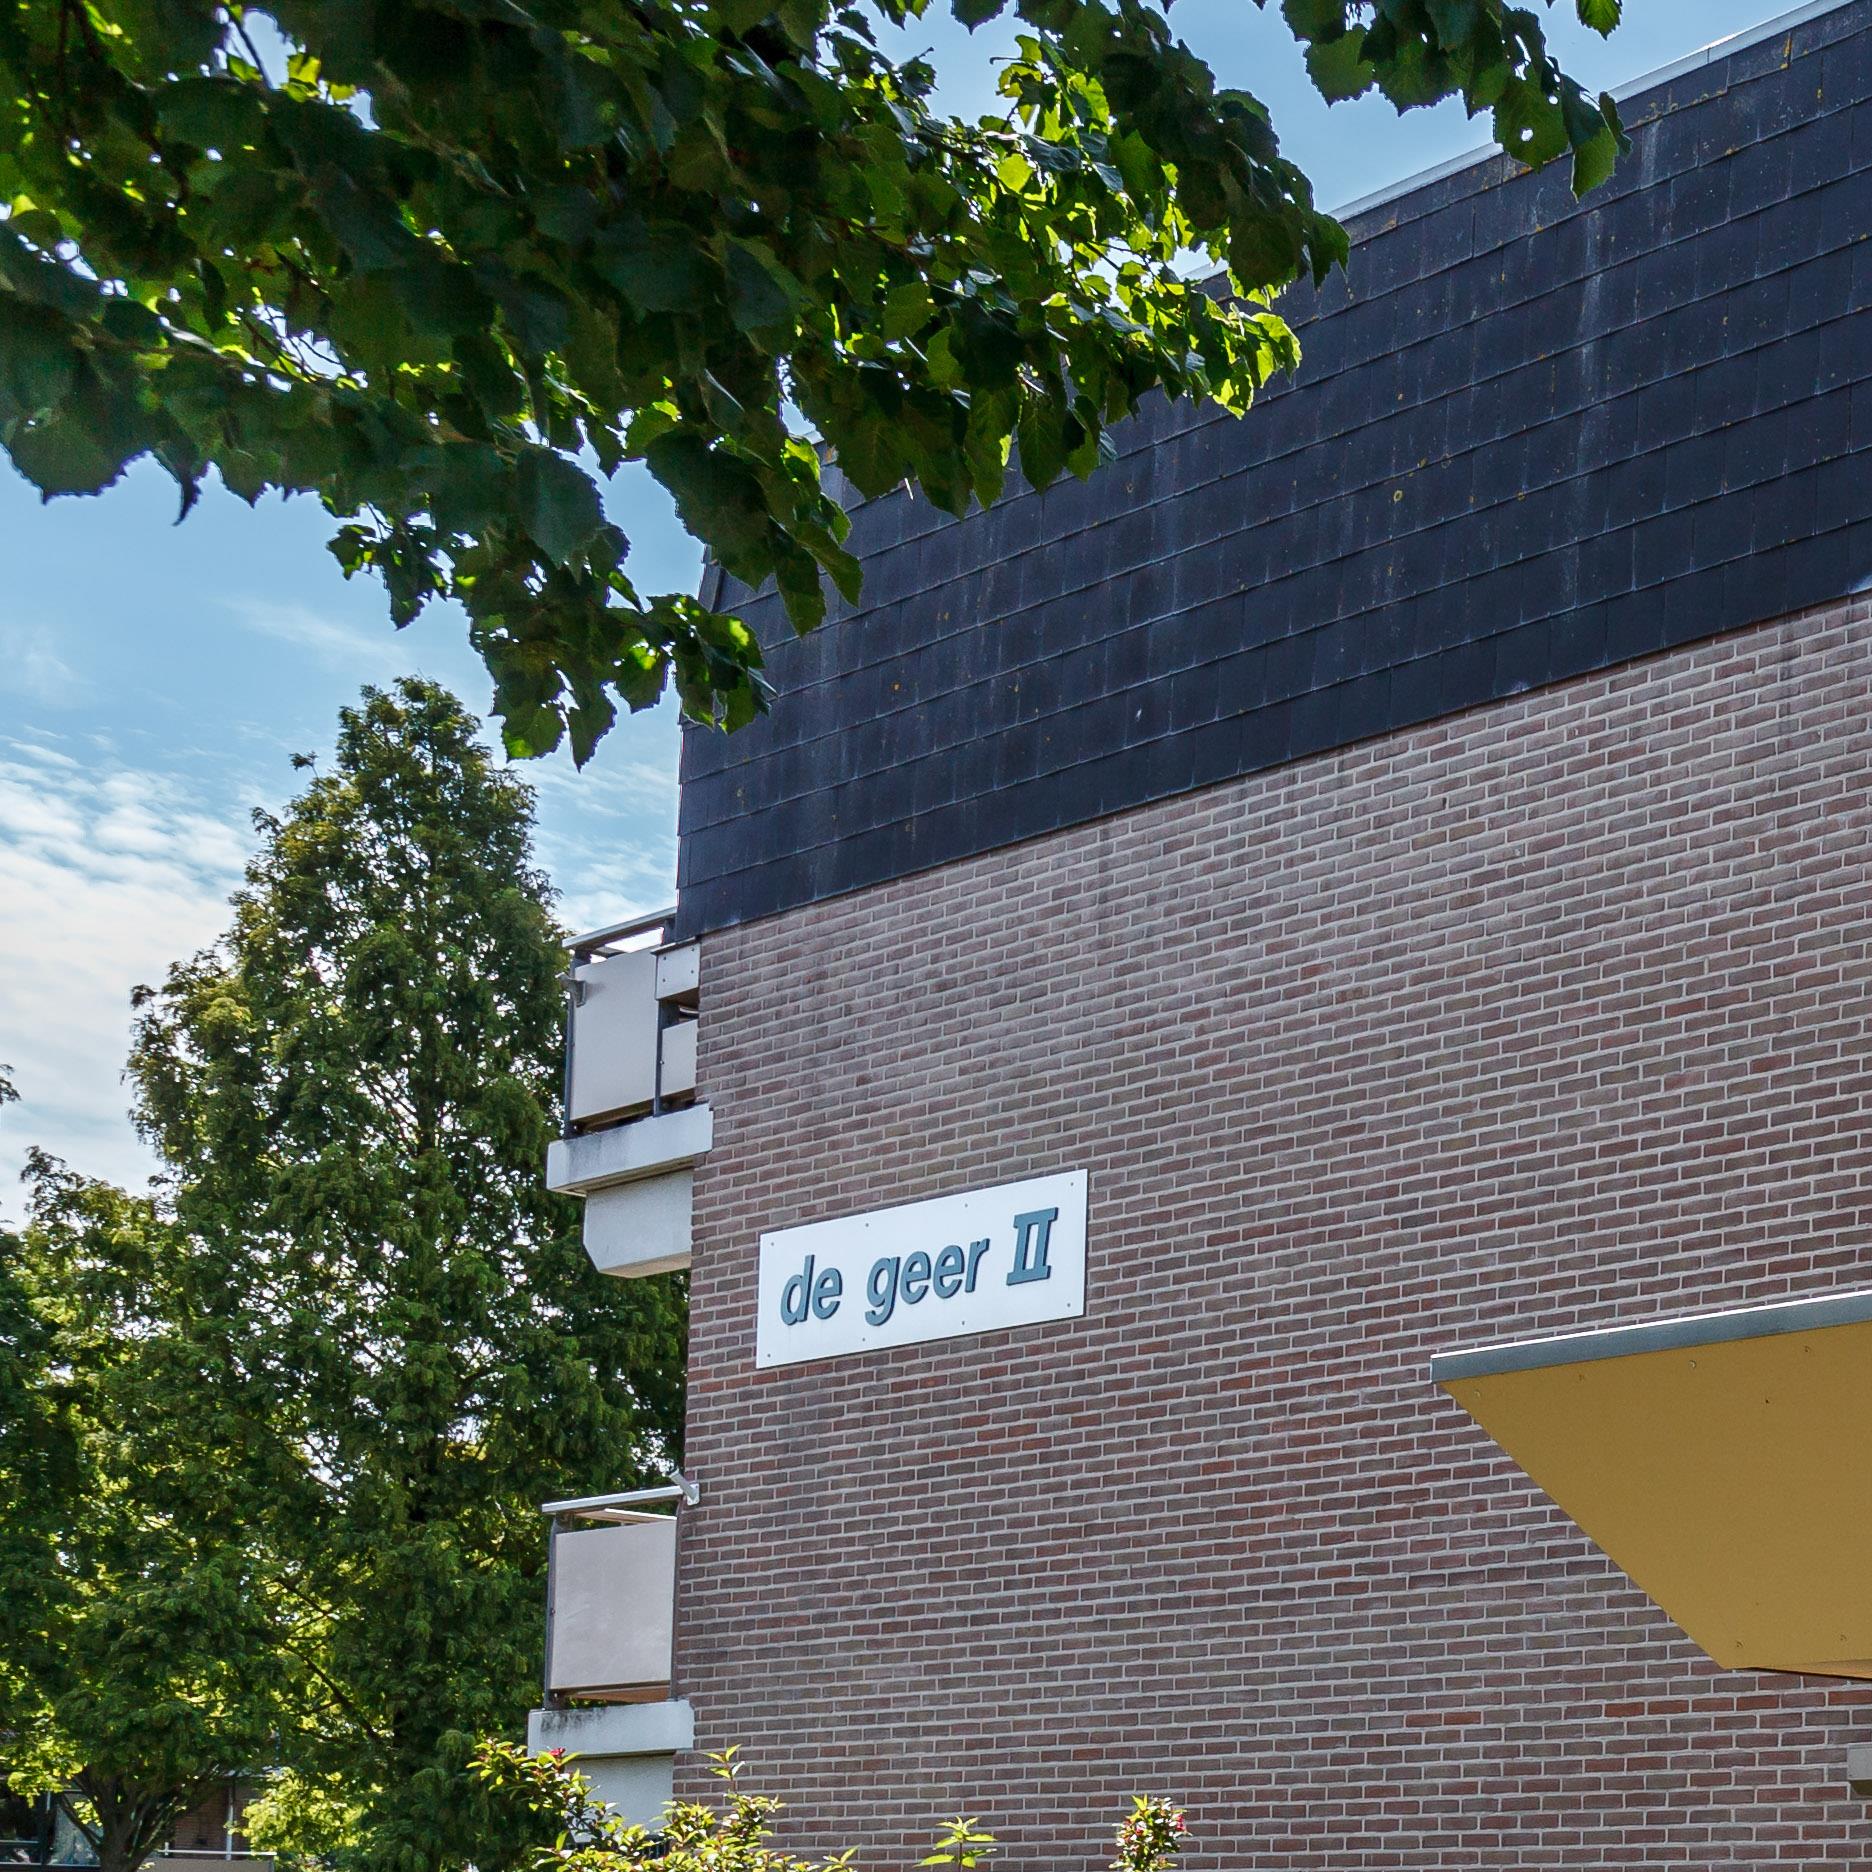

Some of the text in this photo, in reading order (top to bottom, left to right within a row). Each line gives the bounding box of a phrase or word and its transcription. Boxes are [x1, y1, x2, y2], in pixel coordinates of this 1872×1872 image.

[781, 1207, 1058, 1326] de geer II
